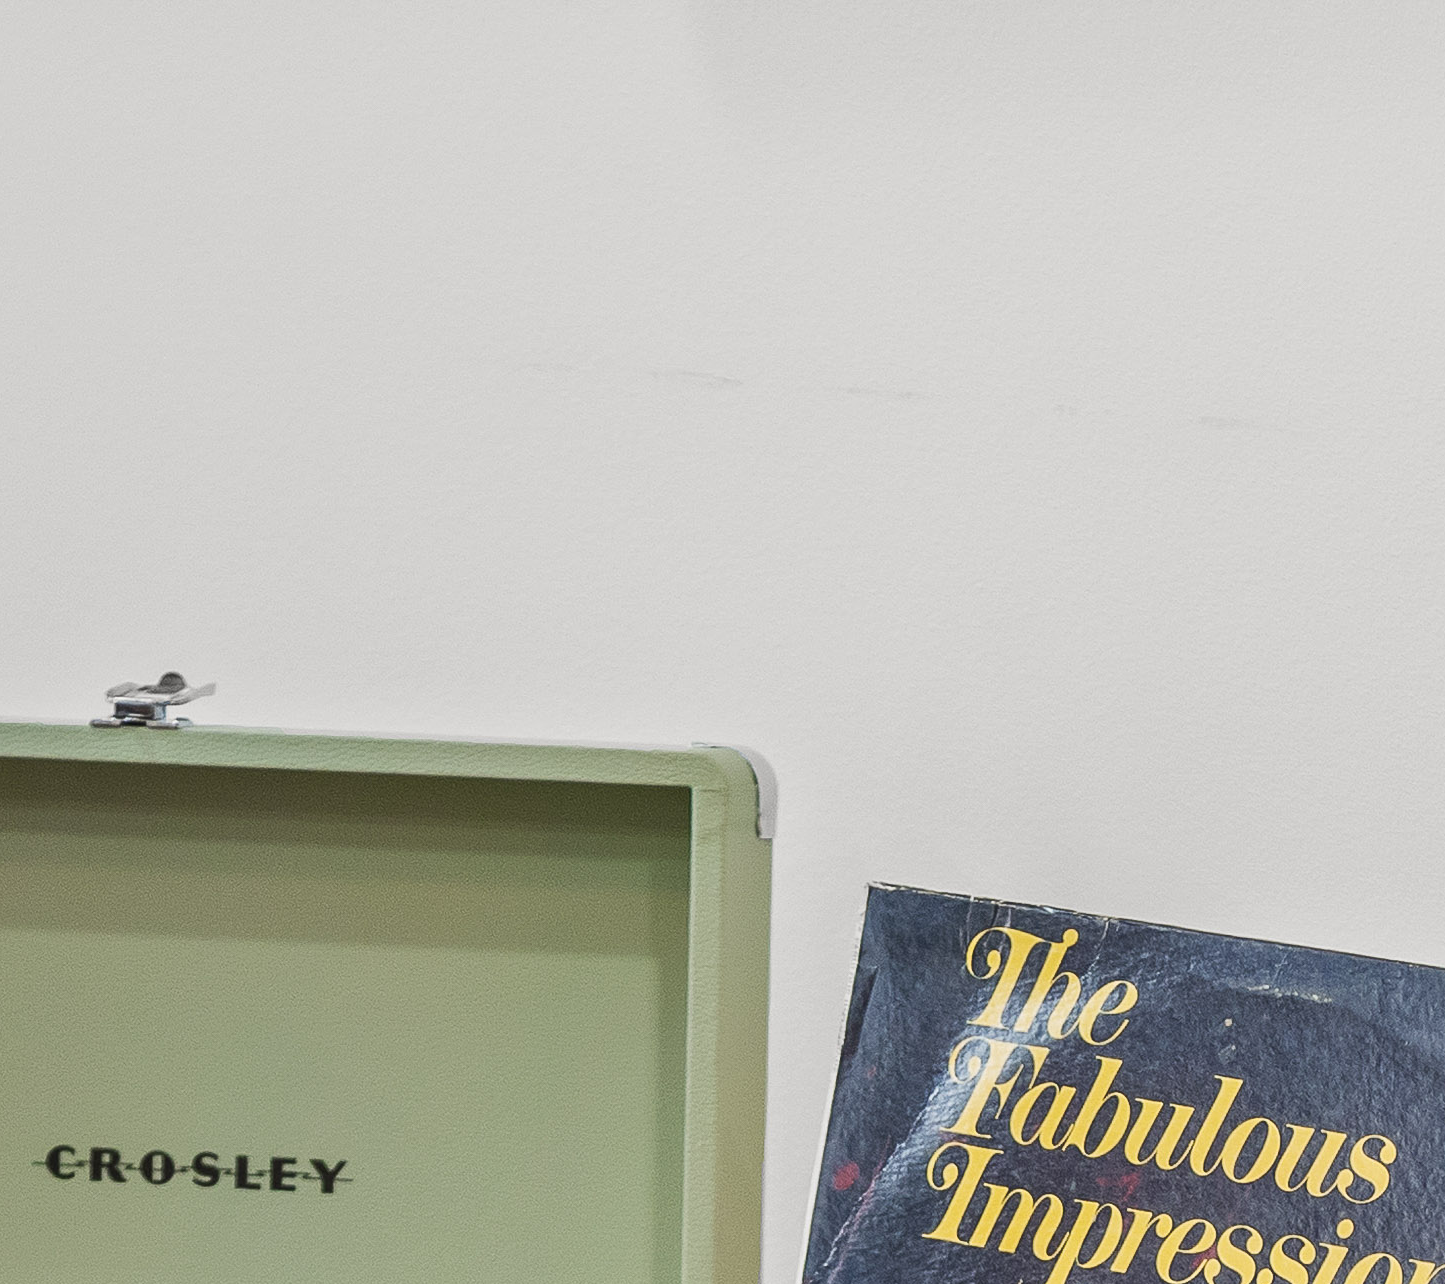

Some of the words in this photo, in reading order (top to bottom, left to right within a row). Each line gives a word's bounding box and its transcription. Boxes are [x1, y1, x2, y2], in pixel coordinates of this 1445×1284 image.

[966, 926, 1139, 1047] The
[45, 1144, 348, 1194] CROSLEY
[941, 1034, 1396, 1204] Fabulous
